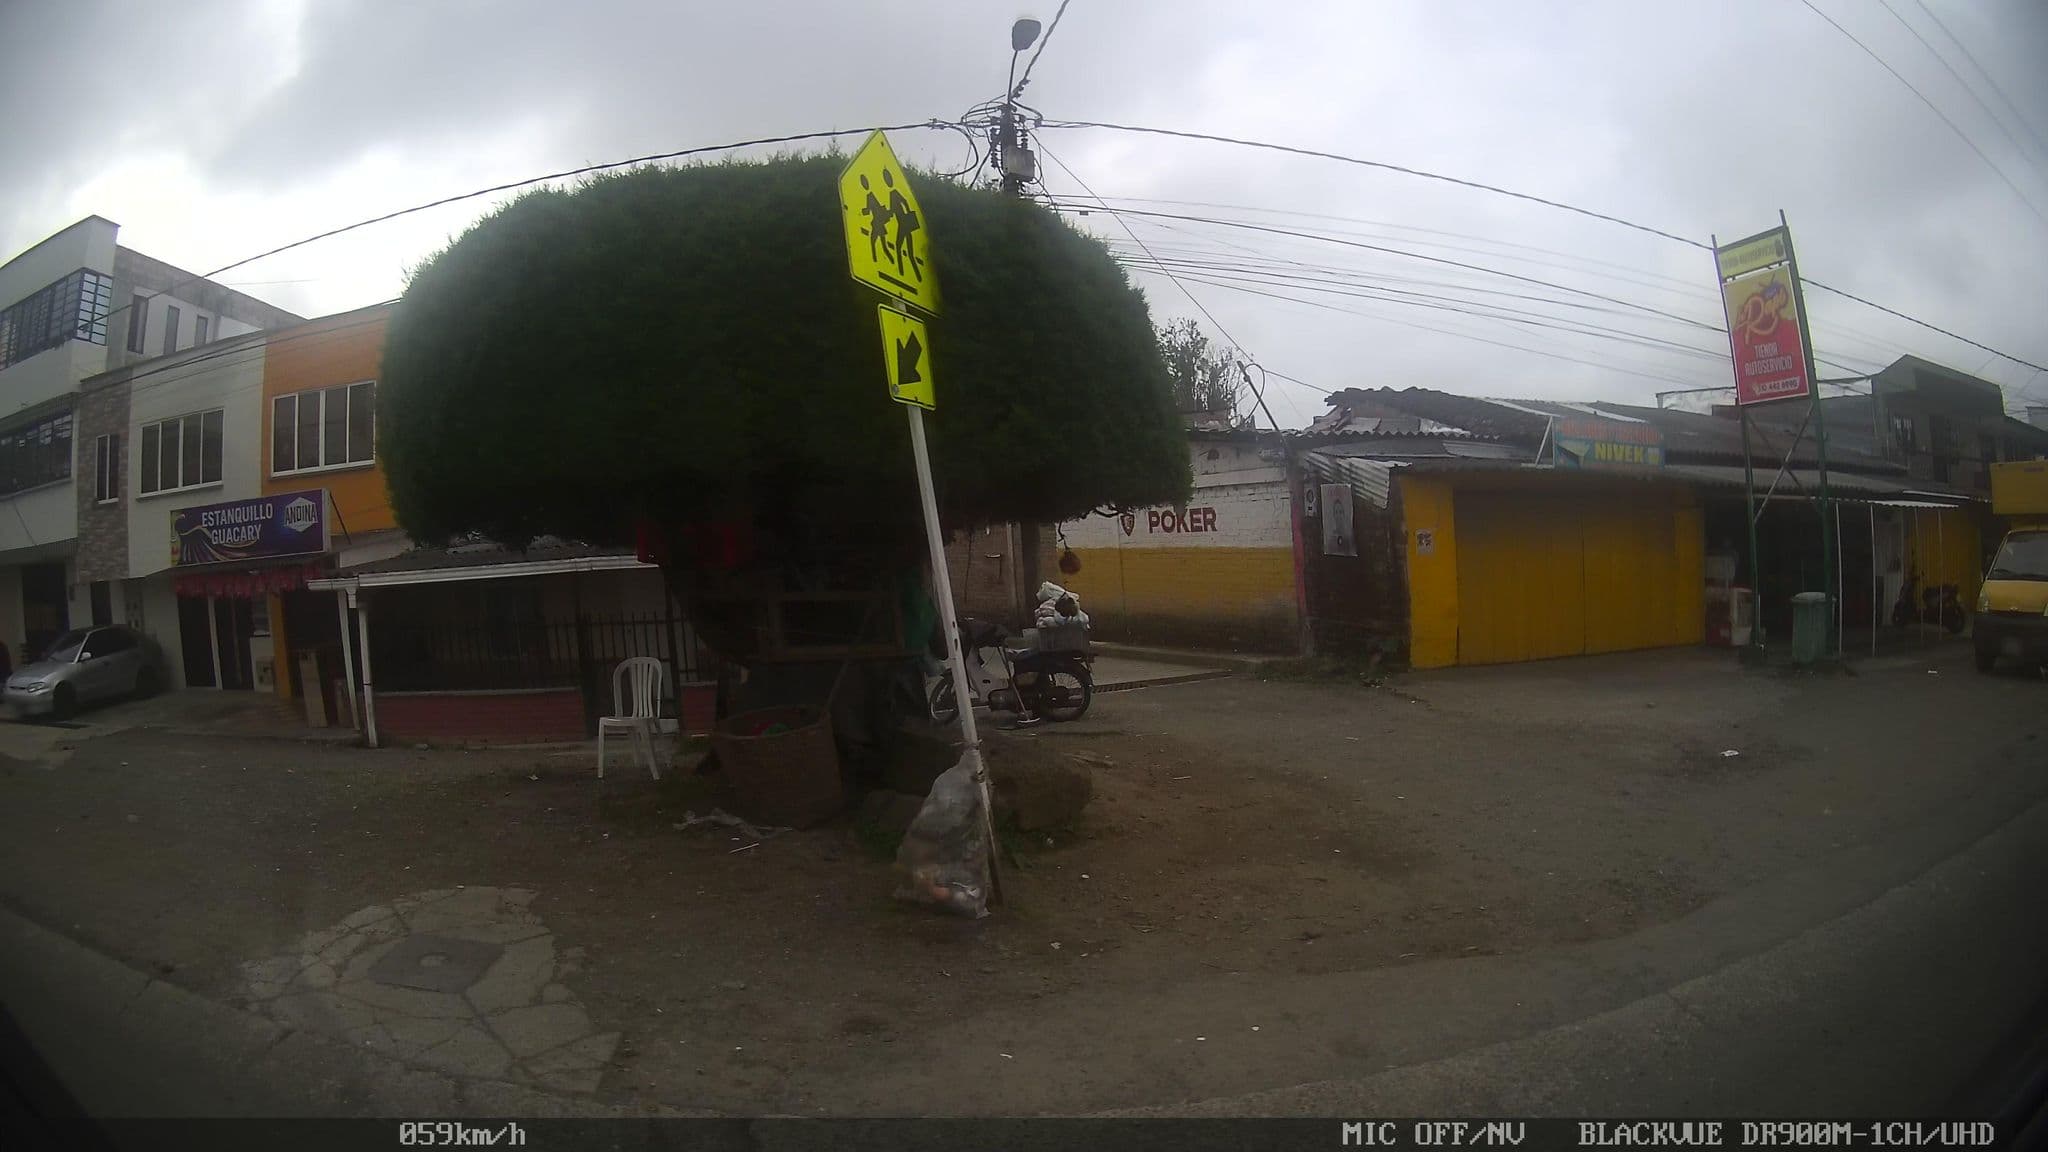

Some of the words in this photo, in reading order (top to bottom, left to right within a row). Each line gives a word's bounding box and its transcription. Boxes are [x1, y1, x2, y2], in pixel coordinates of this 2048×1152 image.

[1744, 355, 1793, 376] AUTOSERVICIO
[201, 503, 273, 527] ESTANQUILLO
[284, 503, 318, 527] ANDINA
[1147, 507, 1217, 534] POKER
[211, 524, 262, 545] GUACARY
